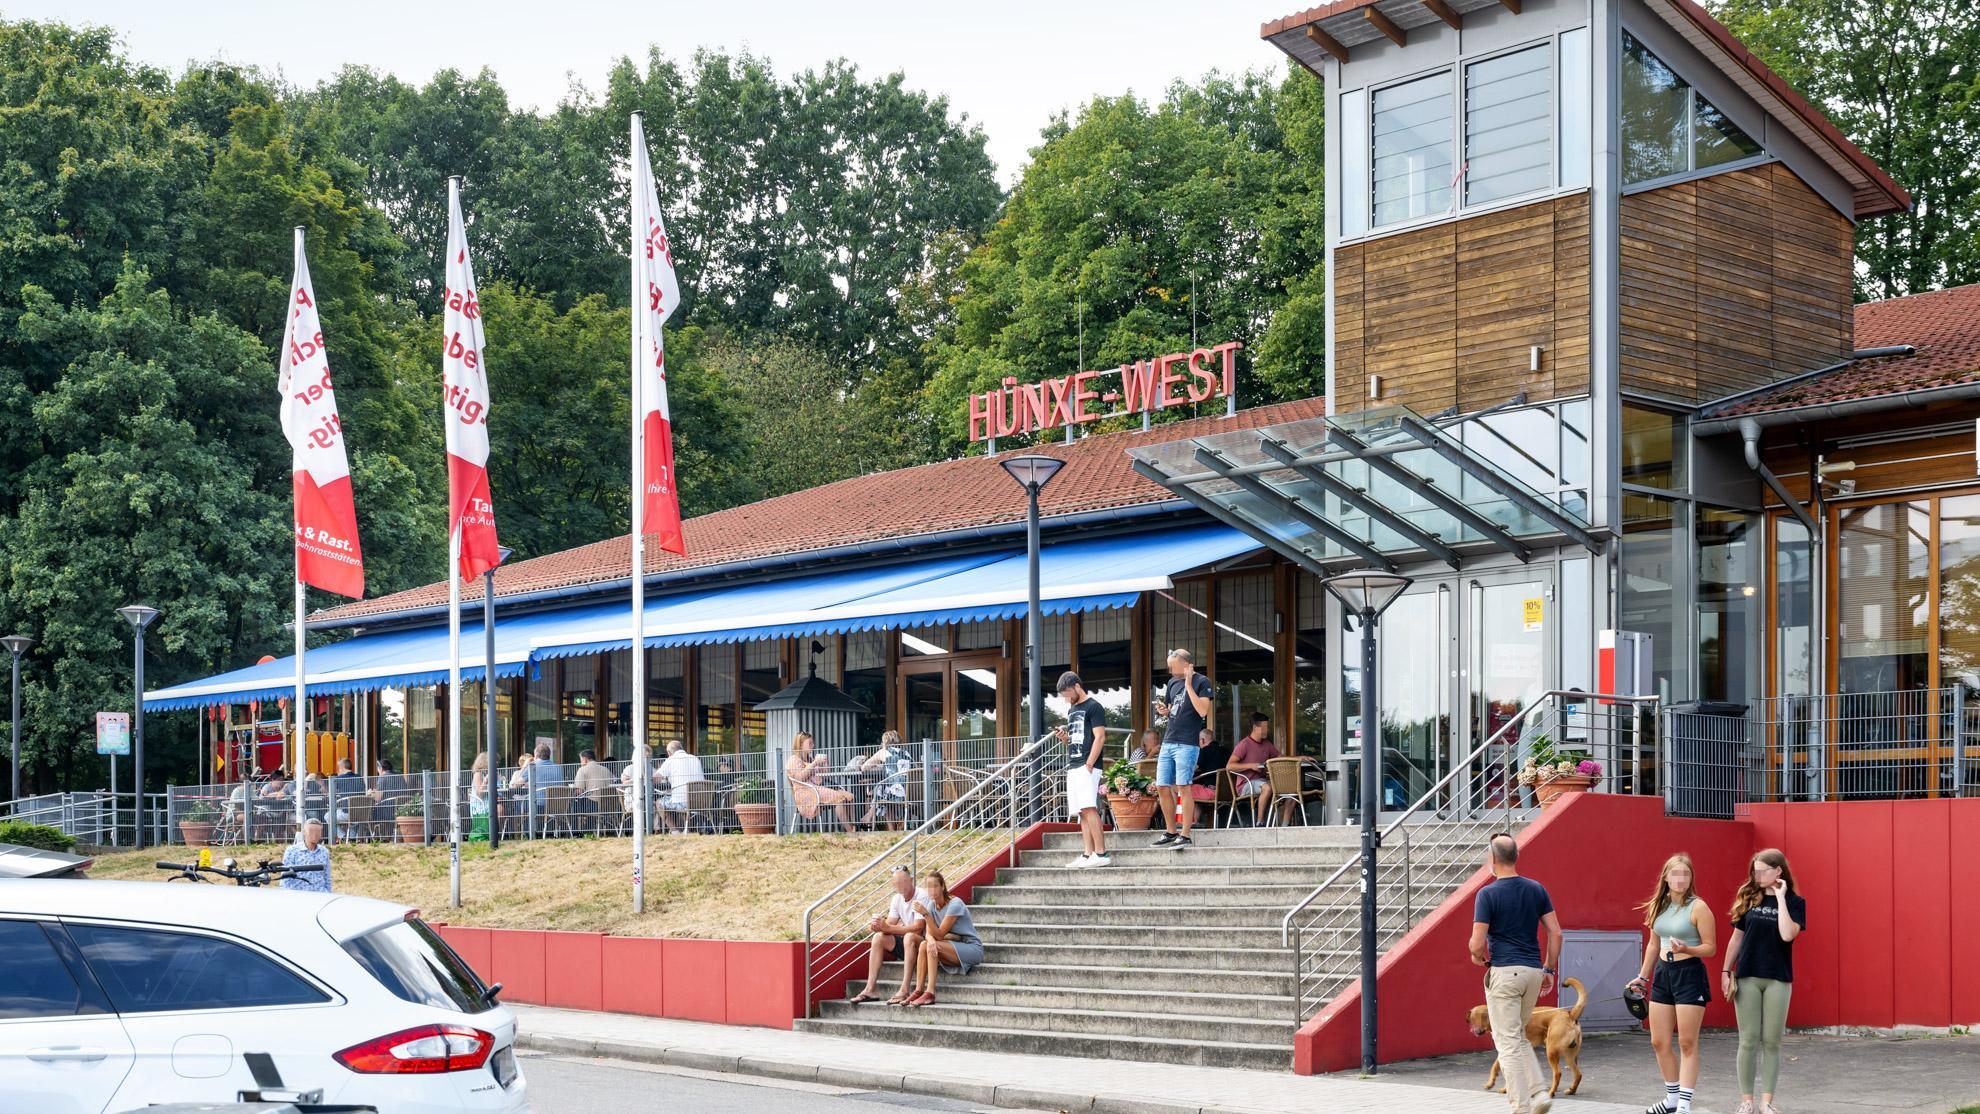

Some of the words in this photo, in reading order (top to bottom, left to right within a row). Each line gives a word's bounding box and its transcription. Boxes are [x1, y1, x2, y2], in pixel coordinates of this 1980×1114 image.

[968, 341, 1244, 443] HÜNXE-WEST
[304, 526, 315, 540] &
[317, 530, 353, 552] Rast.
